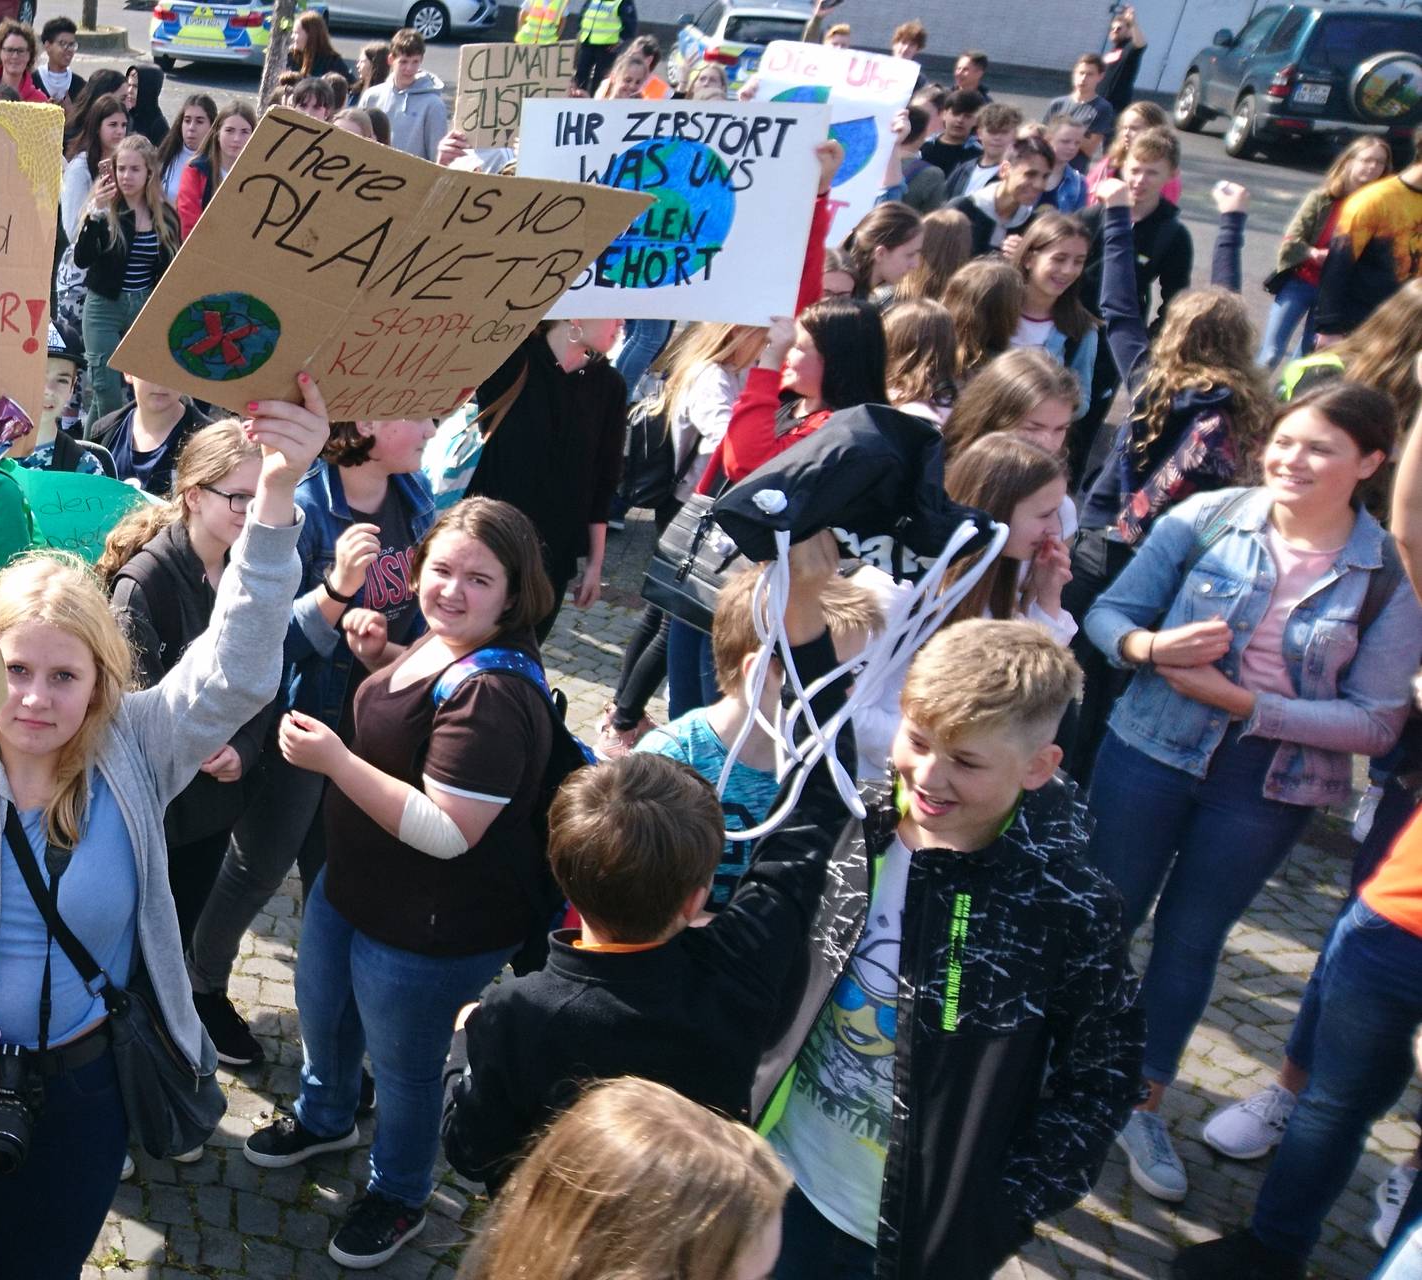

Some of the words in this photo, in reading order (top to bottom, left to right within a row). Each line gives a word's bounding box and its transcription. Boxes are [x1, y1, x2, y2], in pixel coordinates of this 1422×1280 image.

[468, 42, 576, 82] CLIMATE
[767, 47, 818, 78] Die
[845, 56, 900, 91] Uhr
[461, 83, 567, 132] JUST
[555, 110, 605, 147] IHR
[621, 110, 799, 158] ZERSTÖRT
[267, 113, 408, 202] There
[441, 185, 503, 232] IS
[494, 190, 586, 236] NO
[579, 143, 670, 192] WAS
[688, 150, 757, 192] UNS
[238, 172, 540, 301] PLANET
[504, 248, 584, 310] B
[353, 306, 475, 338] Stoppt
[470, 309, 526, 344] den
[328, 341, 474, 383] KLIMA-
[39, 490, 105, 515] den
